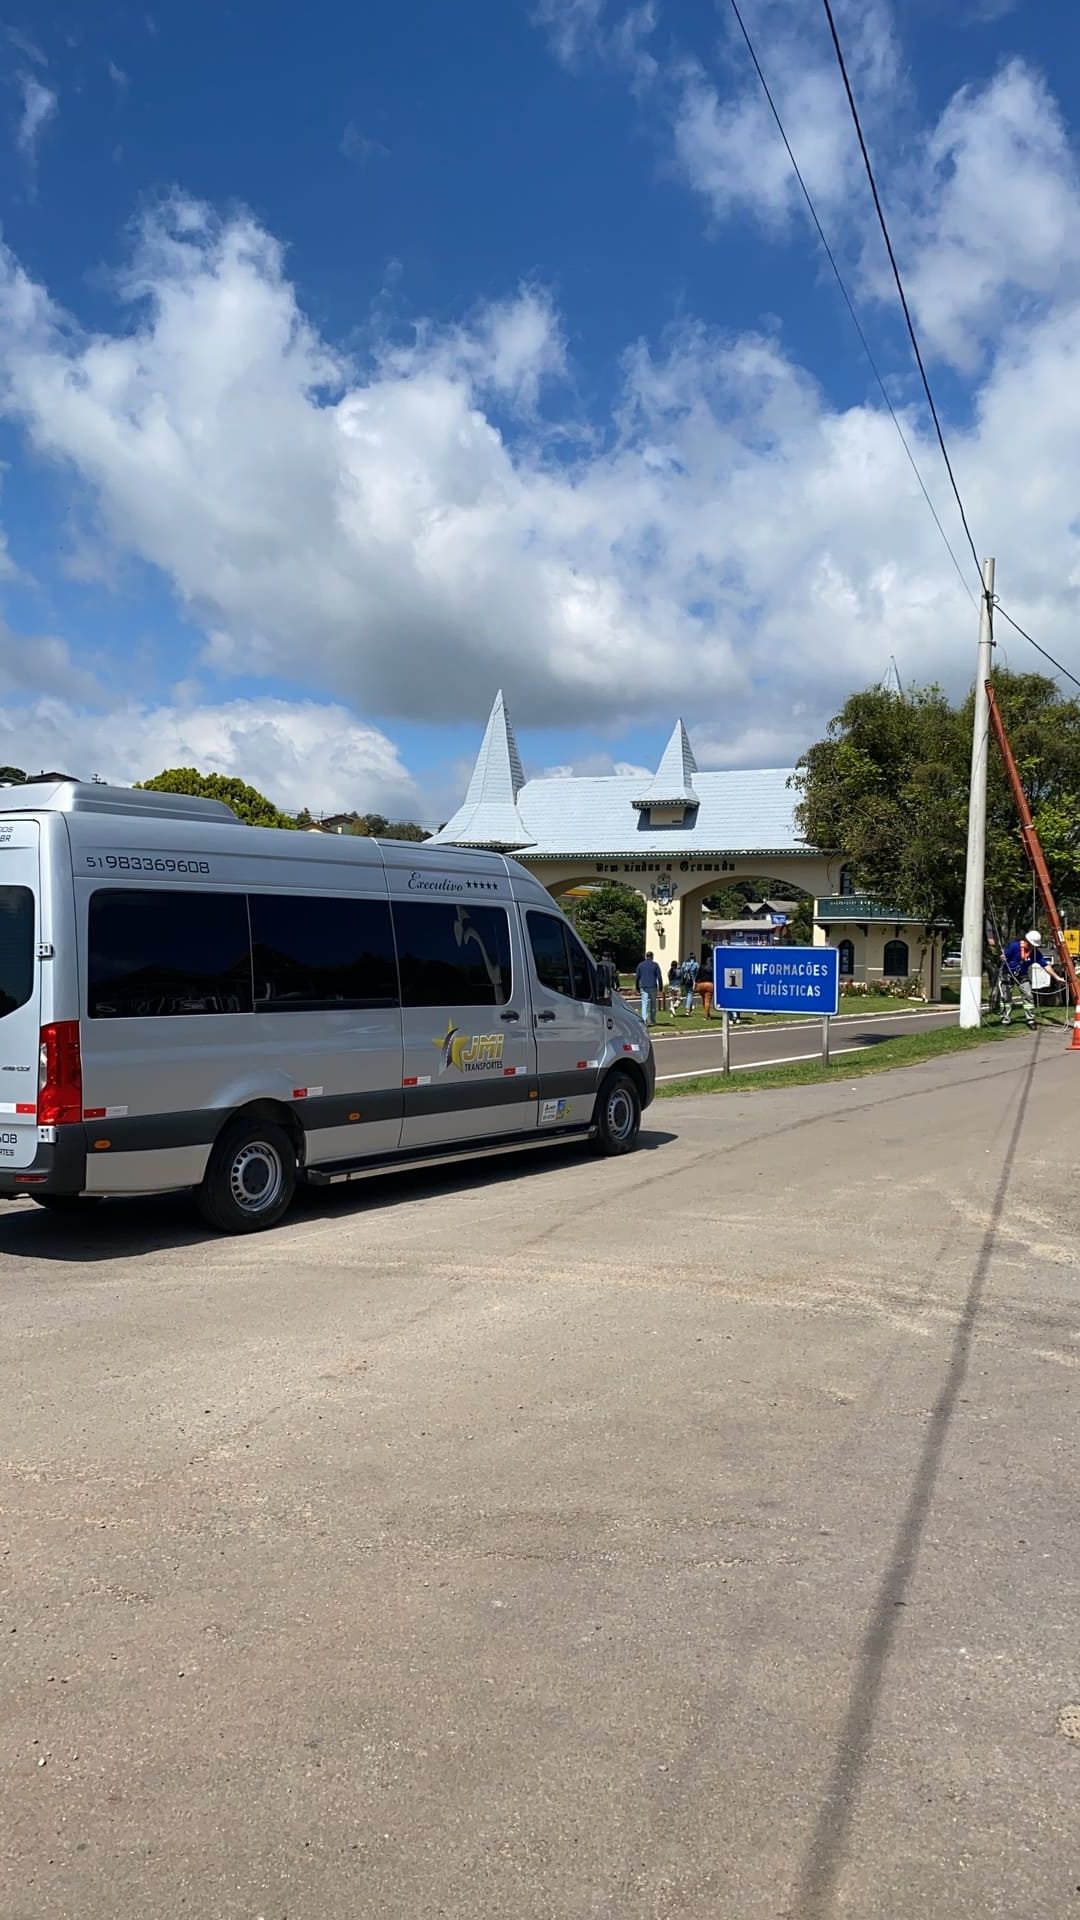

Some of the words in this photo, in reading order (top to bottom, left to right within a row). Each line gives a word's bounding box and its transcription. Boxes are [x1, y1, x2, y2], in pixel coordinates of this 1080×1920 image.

[86, 855, 210, 874] 51983369608
[679, 860, 736, 872] Gramado
[408, 871, 464, 892] Executivo
[750, 961, 829, 977] INFORMAÇÕES
[464, 1060, 504, 1073] TRANSPORTES
